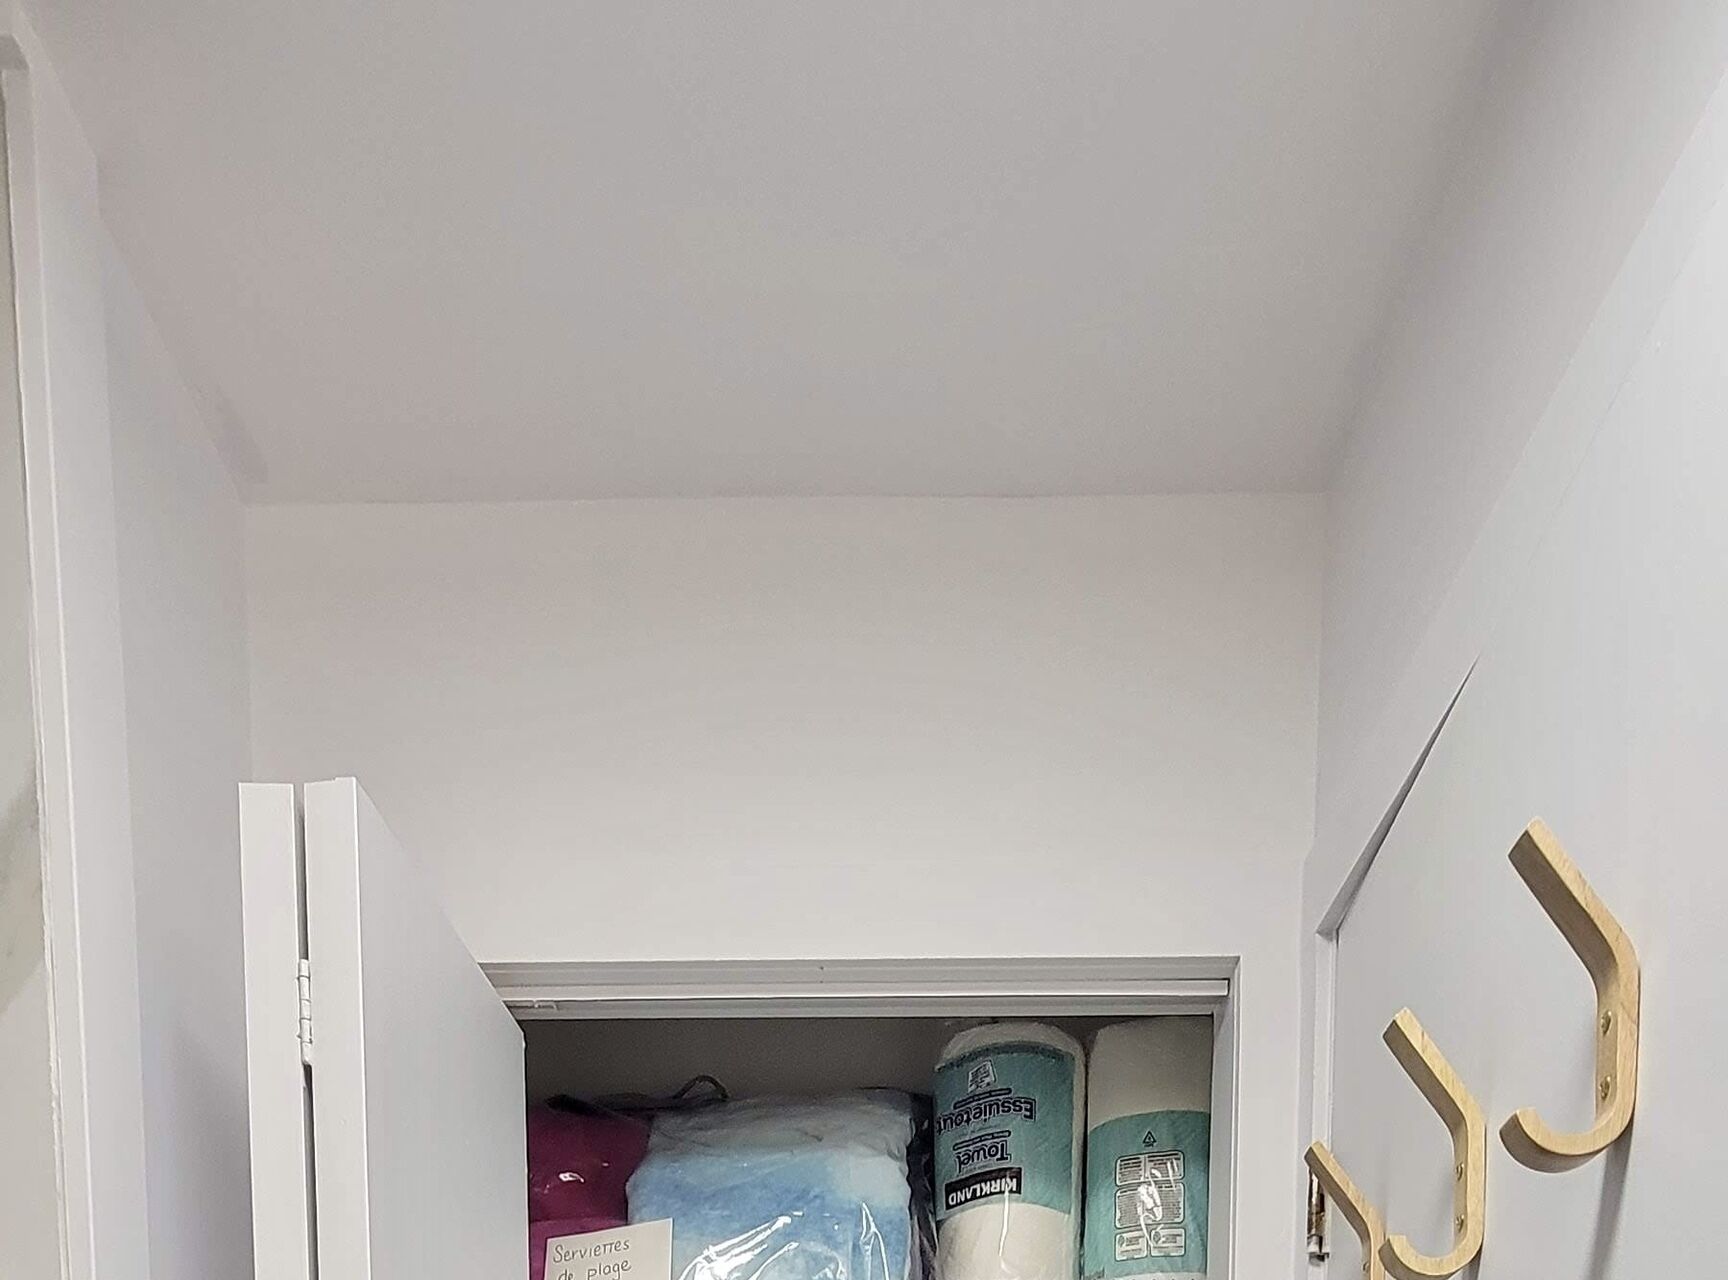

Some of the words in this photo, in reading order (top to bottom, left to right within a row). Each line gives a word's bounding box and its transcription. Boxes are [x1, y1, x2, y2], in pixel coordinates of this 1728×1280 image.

[936, 1098, 1036, 1136] Essuietout
[956, 1142, 1010, 1174] Towel
[948, 1177, 1017, 1206] KIRKLAND
[553, 1239, 630, 1264] Serviettes
